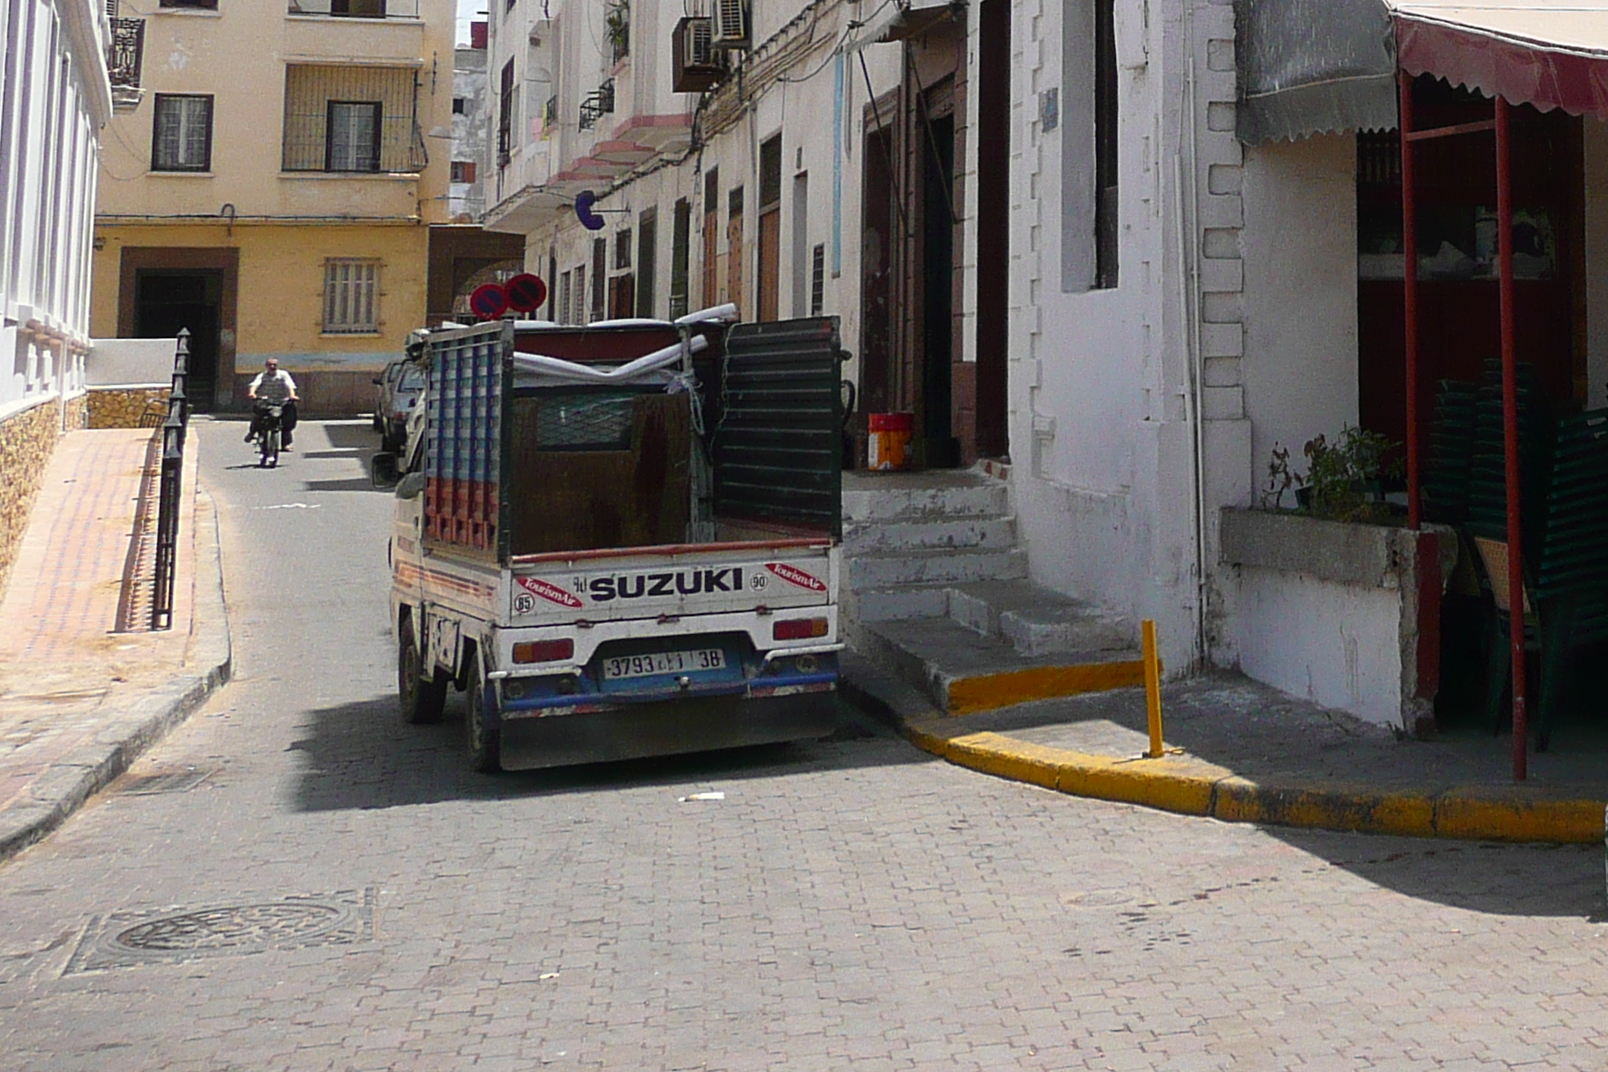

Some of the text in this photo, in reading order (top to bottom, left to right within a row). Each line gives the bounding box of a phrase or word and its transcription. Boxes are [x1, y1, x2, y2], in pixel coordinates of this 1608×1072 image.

[589, 568, 742, 602] SUZUKI
[752, 576, 766, 588] 90
[773, 563, 820, 589] TourismAir
[517, 596, 531, 610] 85
[524, 577, 576, 606] TourismAir
[611, 656, 654, 677] 3793
[699, 650, 720, 668] 38
